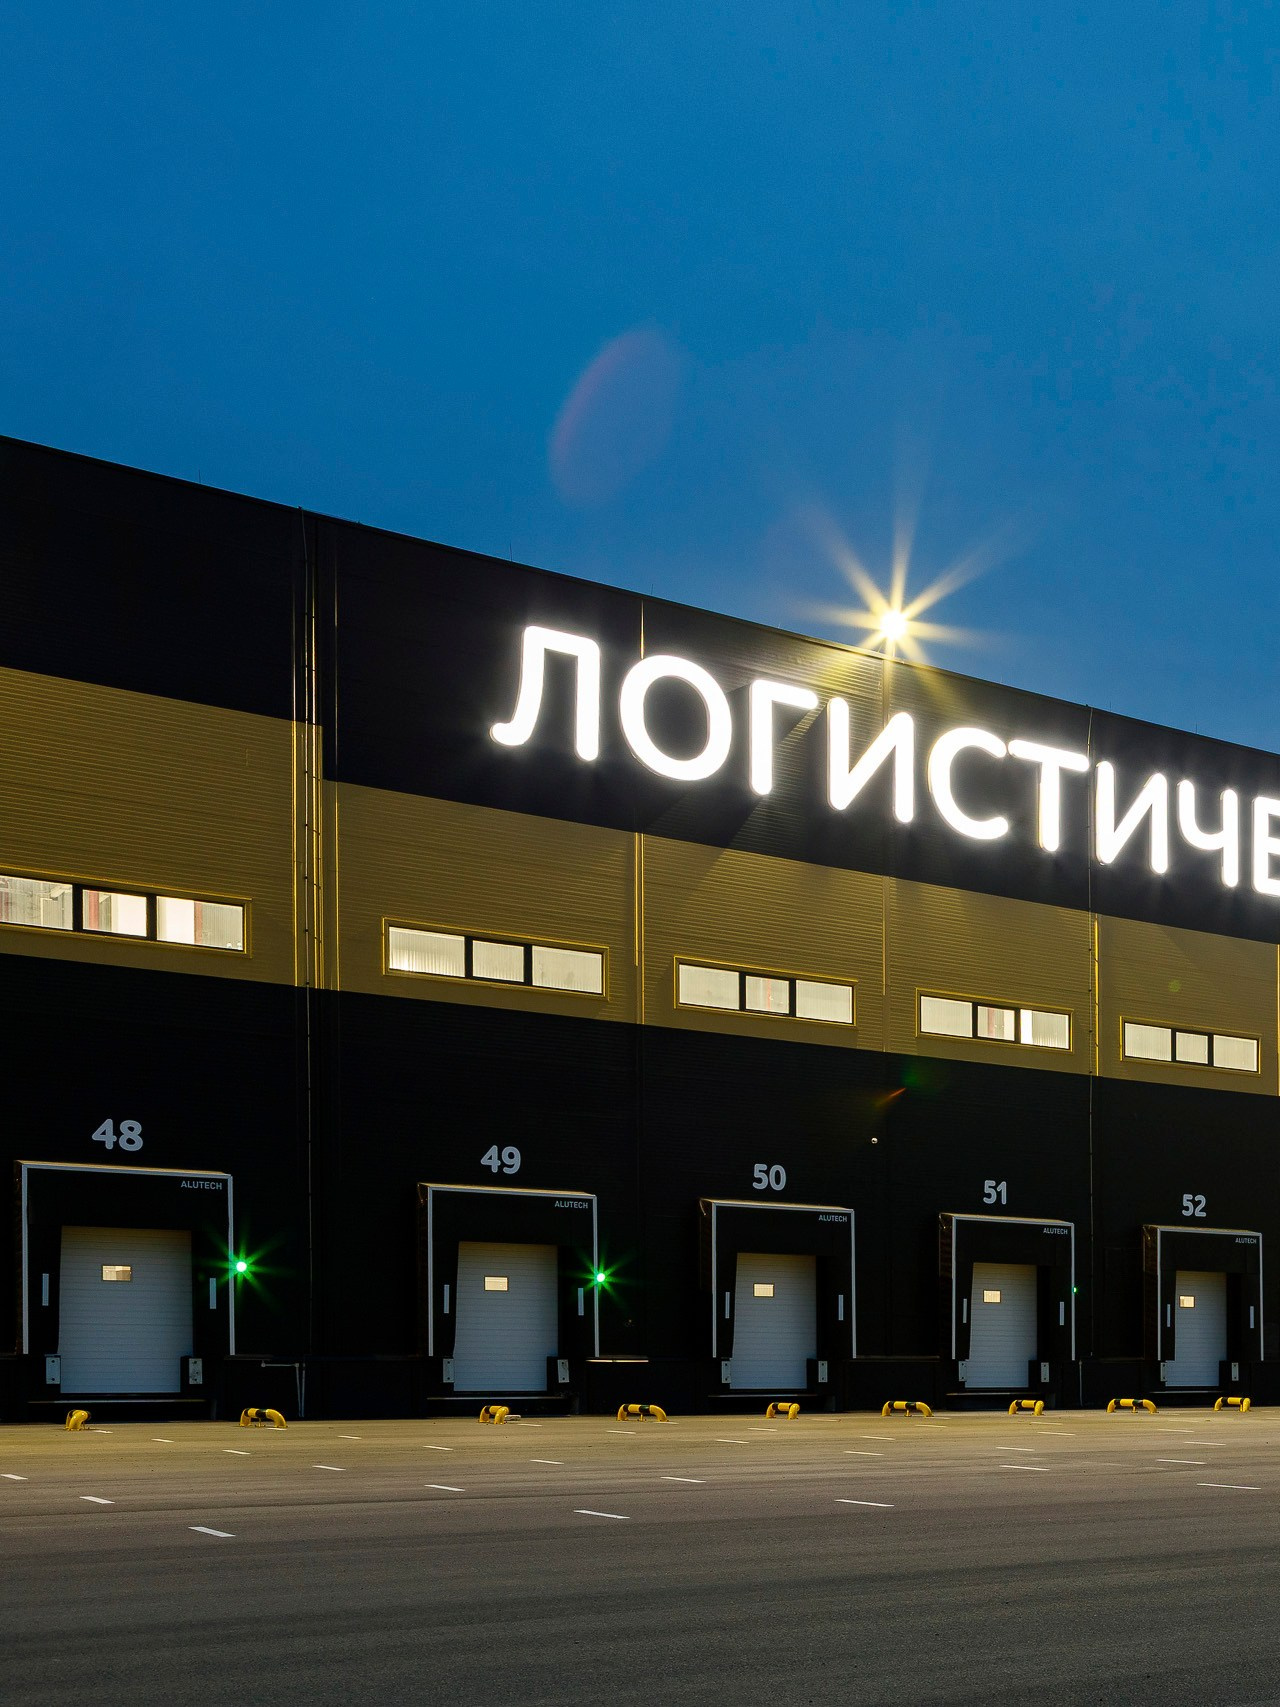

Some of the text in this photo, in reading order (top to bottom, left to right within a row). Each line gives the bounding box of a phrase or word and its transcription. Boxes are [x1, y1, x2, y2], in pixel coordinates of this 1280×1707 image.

[92, 1118, 143, 1151] 48
[480, 1145, 521, 1174] 49
[180, 1180, 222, 1190] ALUTECH
[752, 1163, 787, 1191] 50
[982, 1179, 1007, 1205] 51
[554, 1200, 588, 1210] ALUTECH
[1181, 1193, 1207, 1217] 52
[818, 1214, 848, 1223] ALUTECH
[1043, 1227, 1068, 1235] ALUTECH
[1235, 1237, 1257, 1245] ALUTECH
